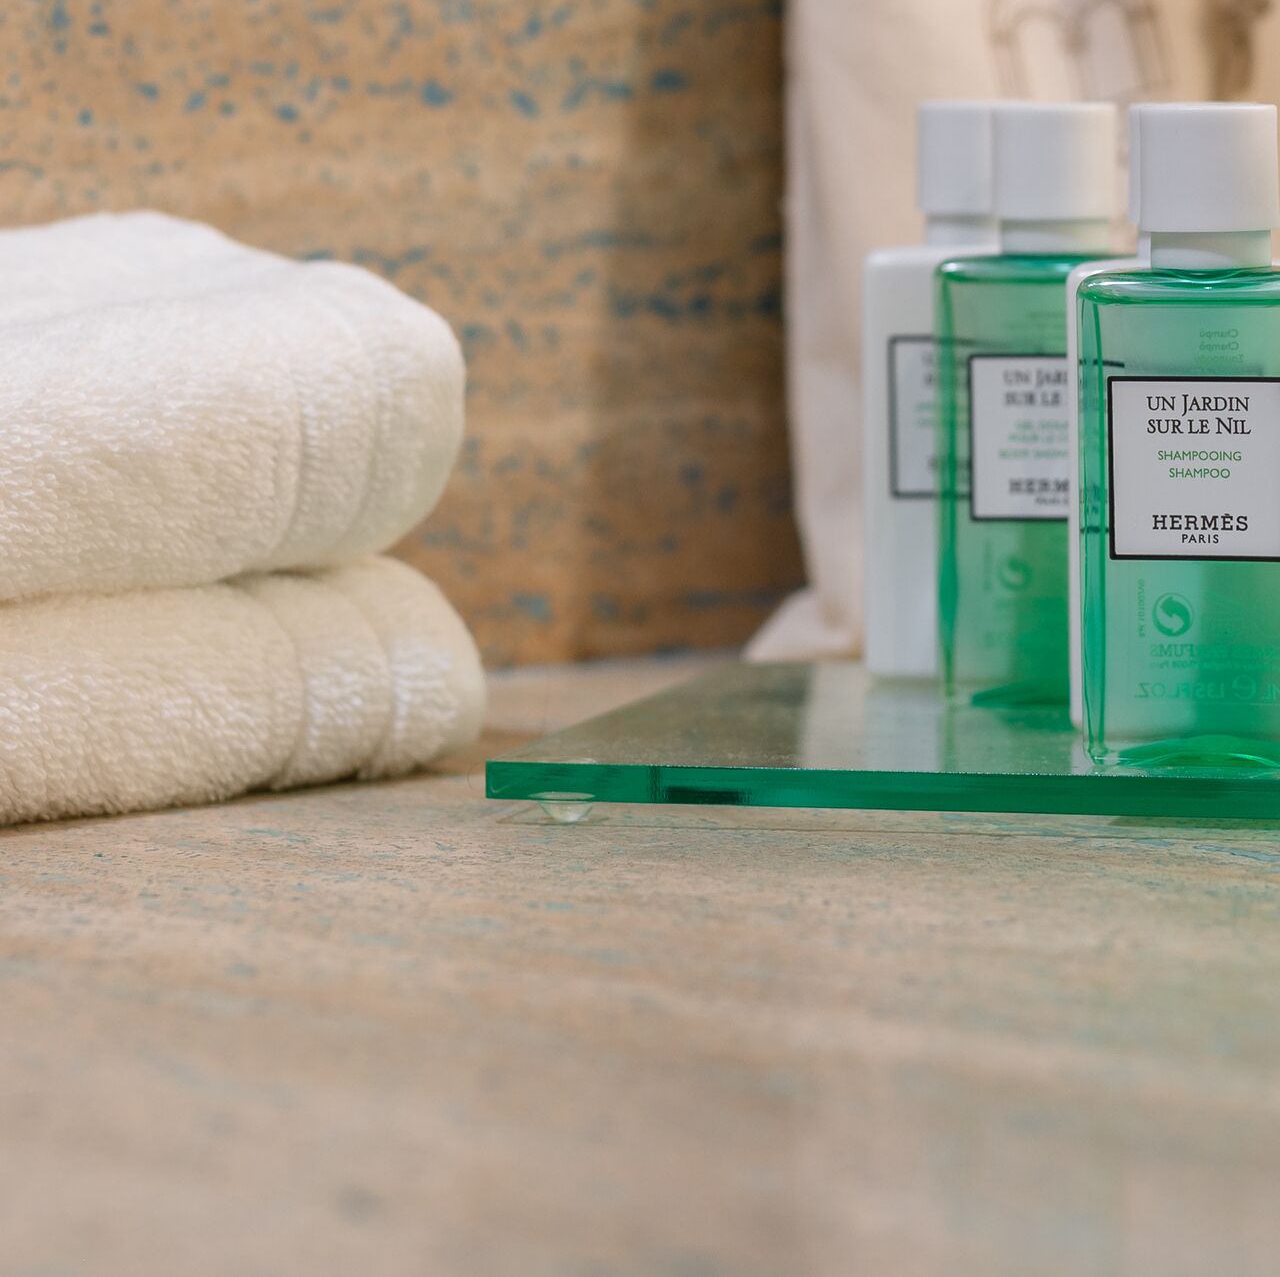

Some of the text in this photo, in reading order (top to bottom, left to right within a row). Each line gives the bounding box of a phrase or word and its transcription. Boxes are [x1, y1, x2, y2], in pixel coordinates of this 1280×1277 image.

[1146, 394, 1251, 417] UN JARDIN
[1146, 417, 1252, 435] SUR LE NIL
[1157, 450, 1243, 462] SHAMPOOING
[1169, 468, 1231, 479] SHAMPOO
[1152, 513, 1249, 532] HERMÈS
[1181, 534, 1220, 544] PARIS
